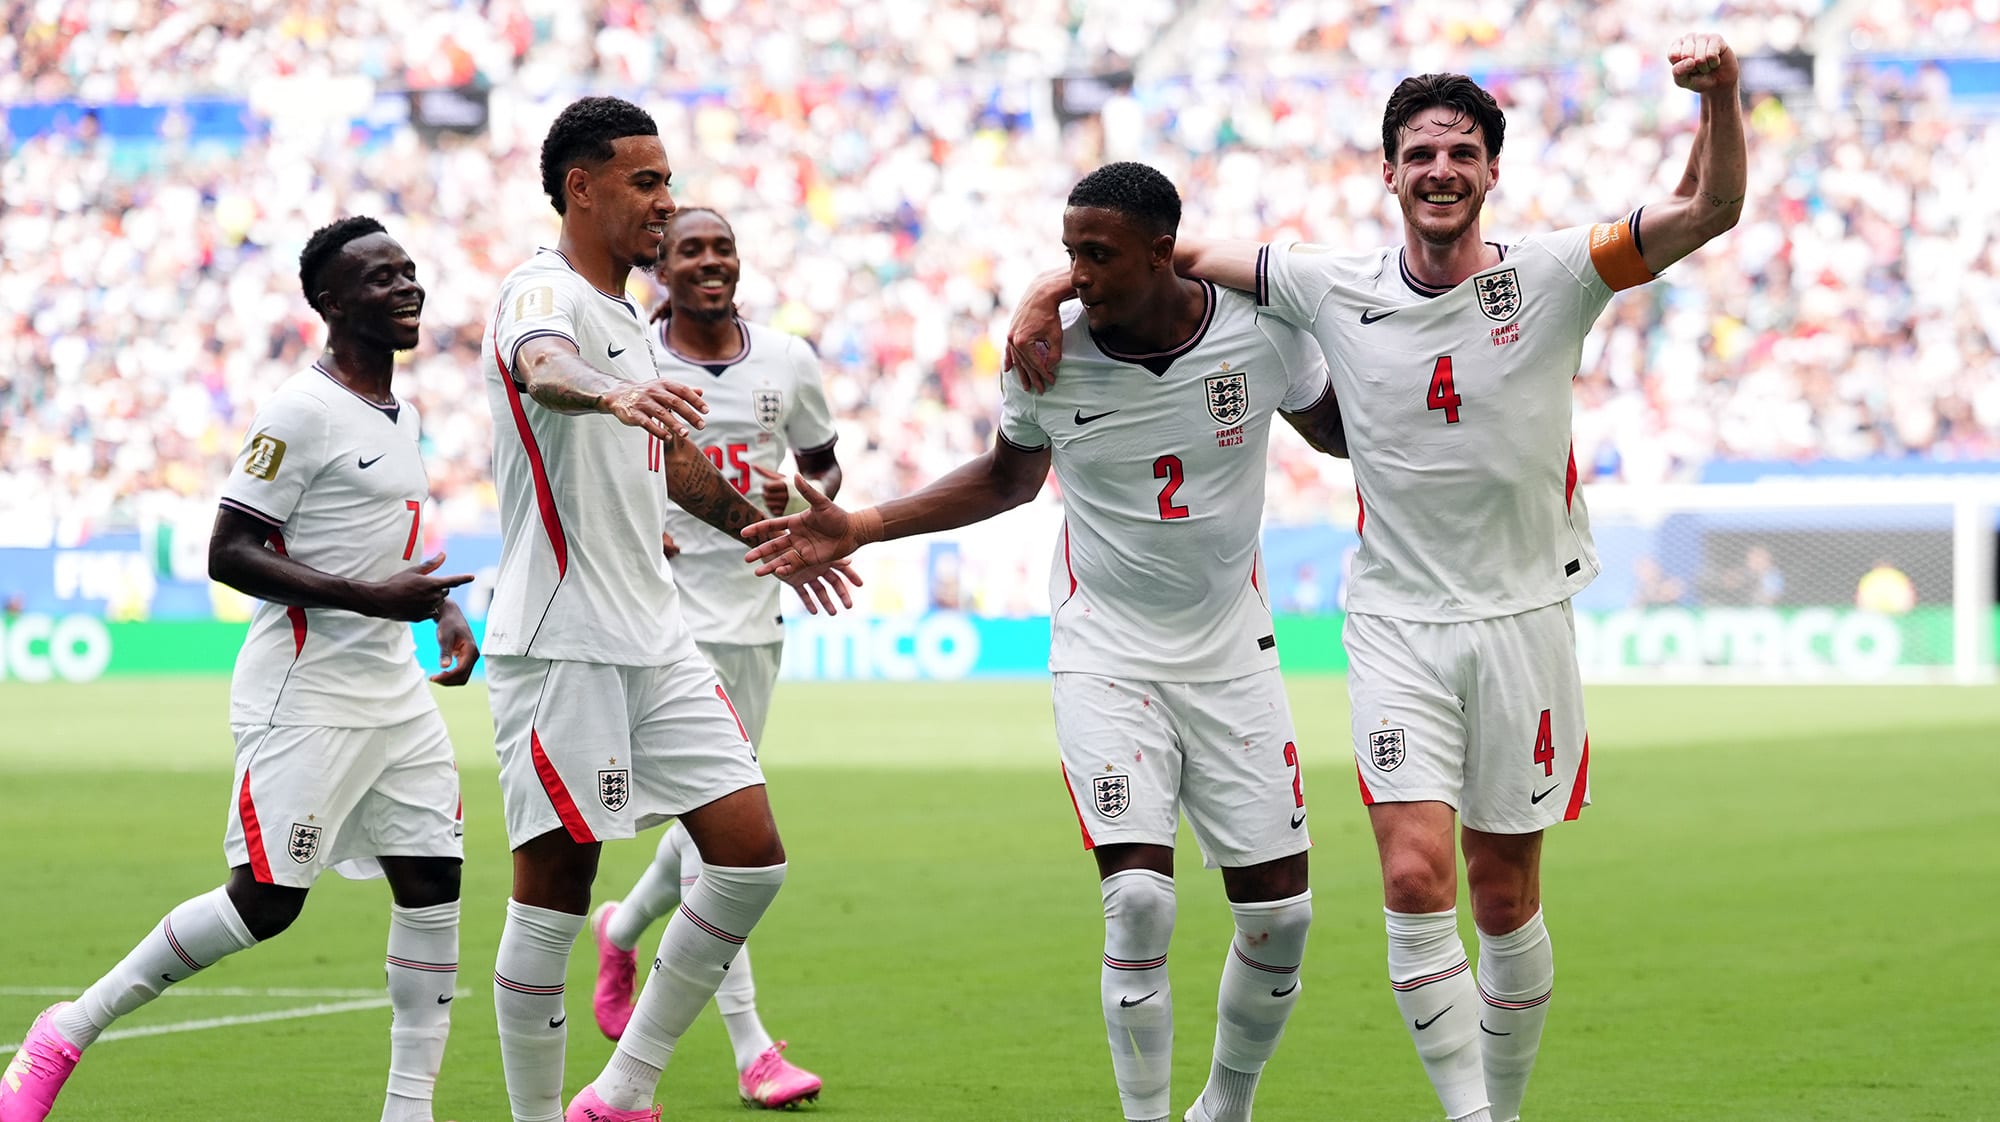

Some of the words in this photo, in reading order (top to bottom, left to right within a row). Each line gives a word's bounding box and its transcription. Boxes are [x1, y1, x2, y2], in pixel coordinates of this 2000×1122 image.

[1490, 323, 1520, 337] FRANCE
[1426, 355, 1462, 424] 4
[1216, 425, 1244, 439] FRANCE
[1153, 454, 1190, 520] 2
[402, 499, 420, 561] 7
[1283, 741, 1304, 808] 2
[1533, 709, 1555, 777] 4
